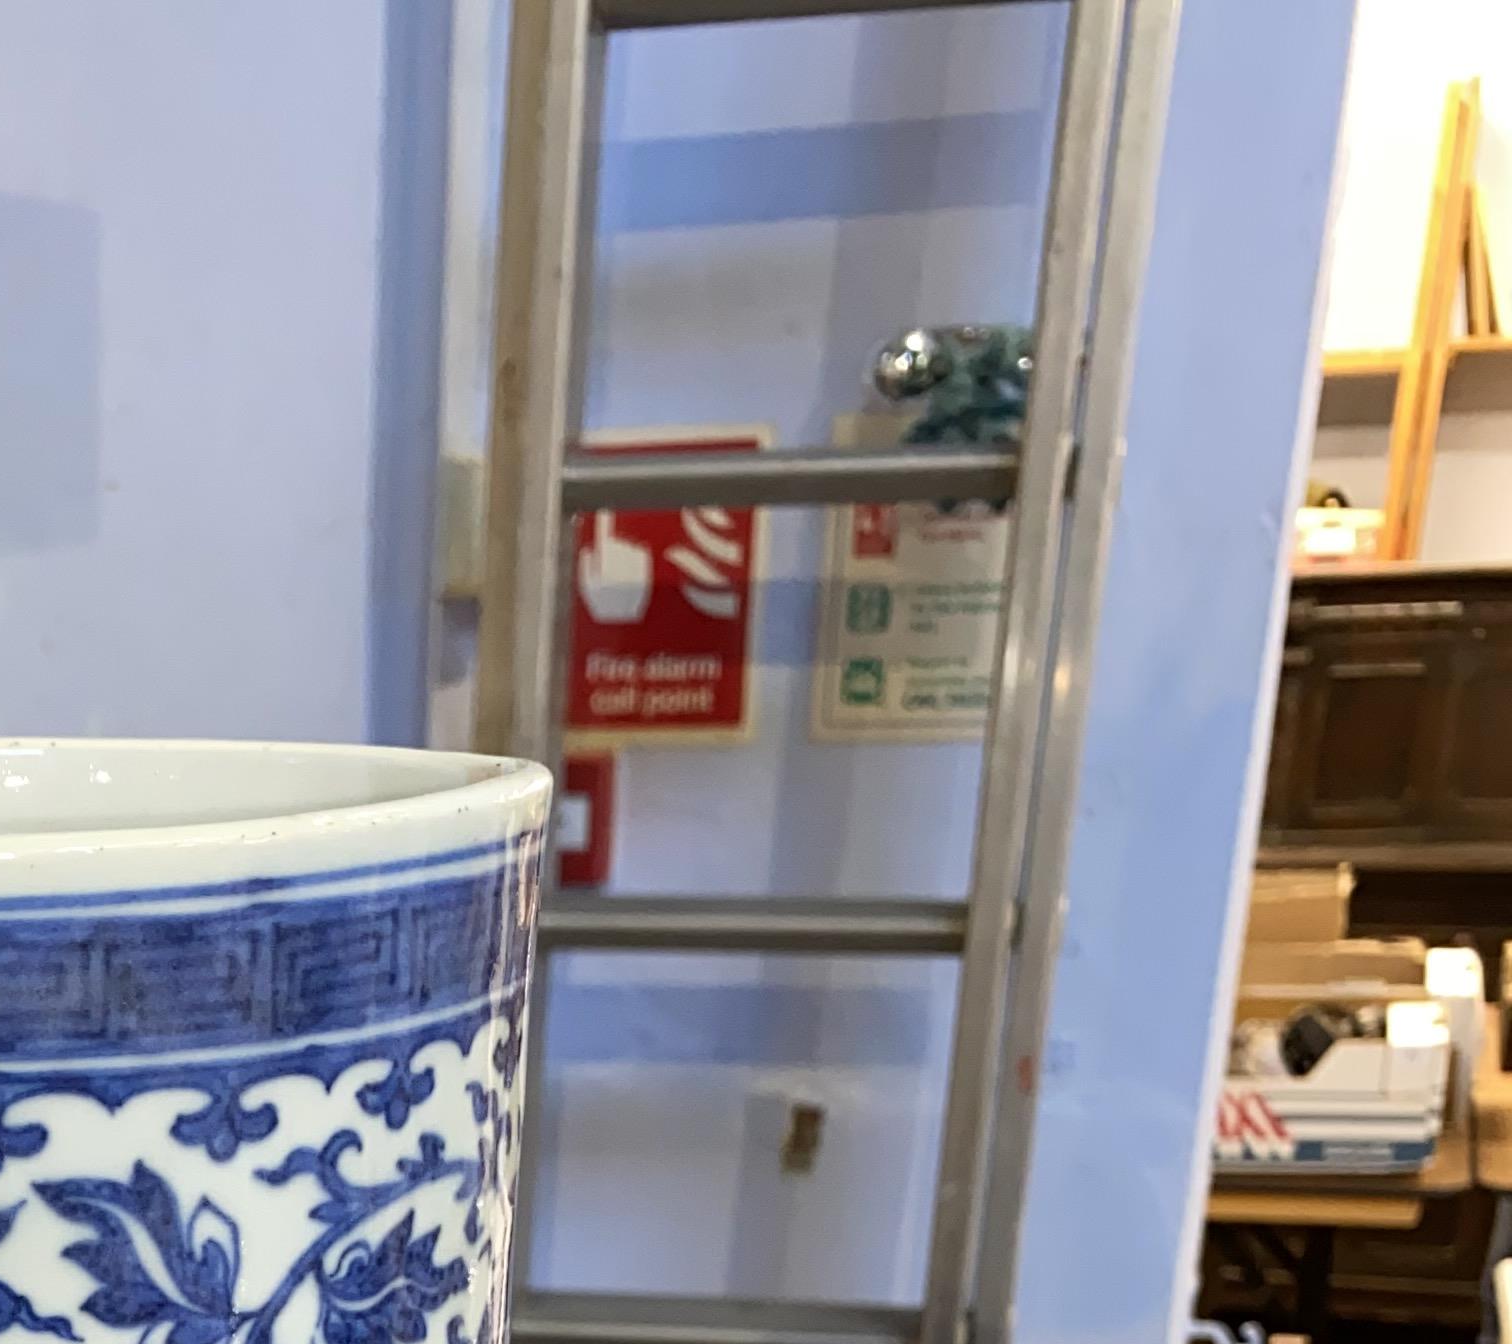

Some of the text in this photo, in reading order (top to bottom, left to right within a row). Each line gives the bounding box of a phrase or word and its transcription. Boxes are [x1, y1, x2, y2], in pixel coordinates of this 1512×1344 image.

[585, 652, 722, 679] Fire alarm
[590, 686, 714, 718] call point
